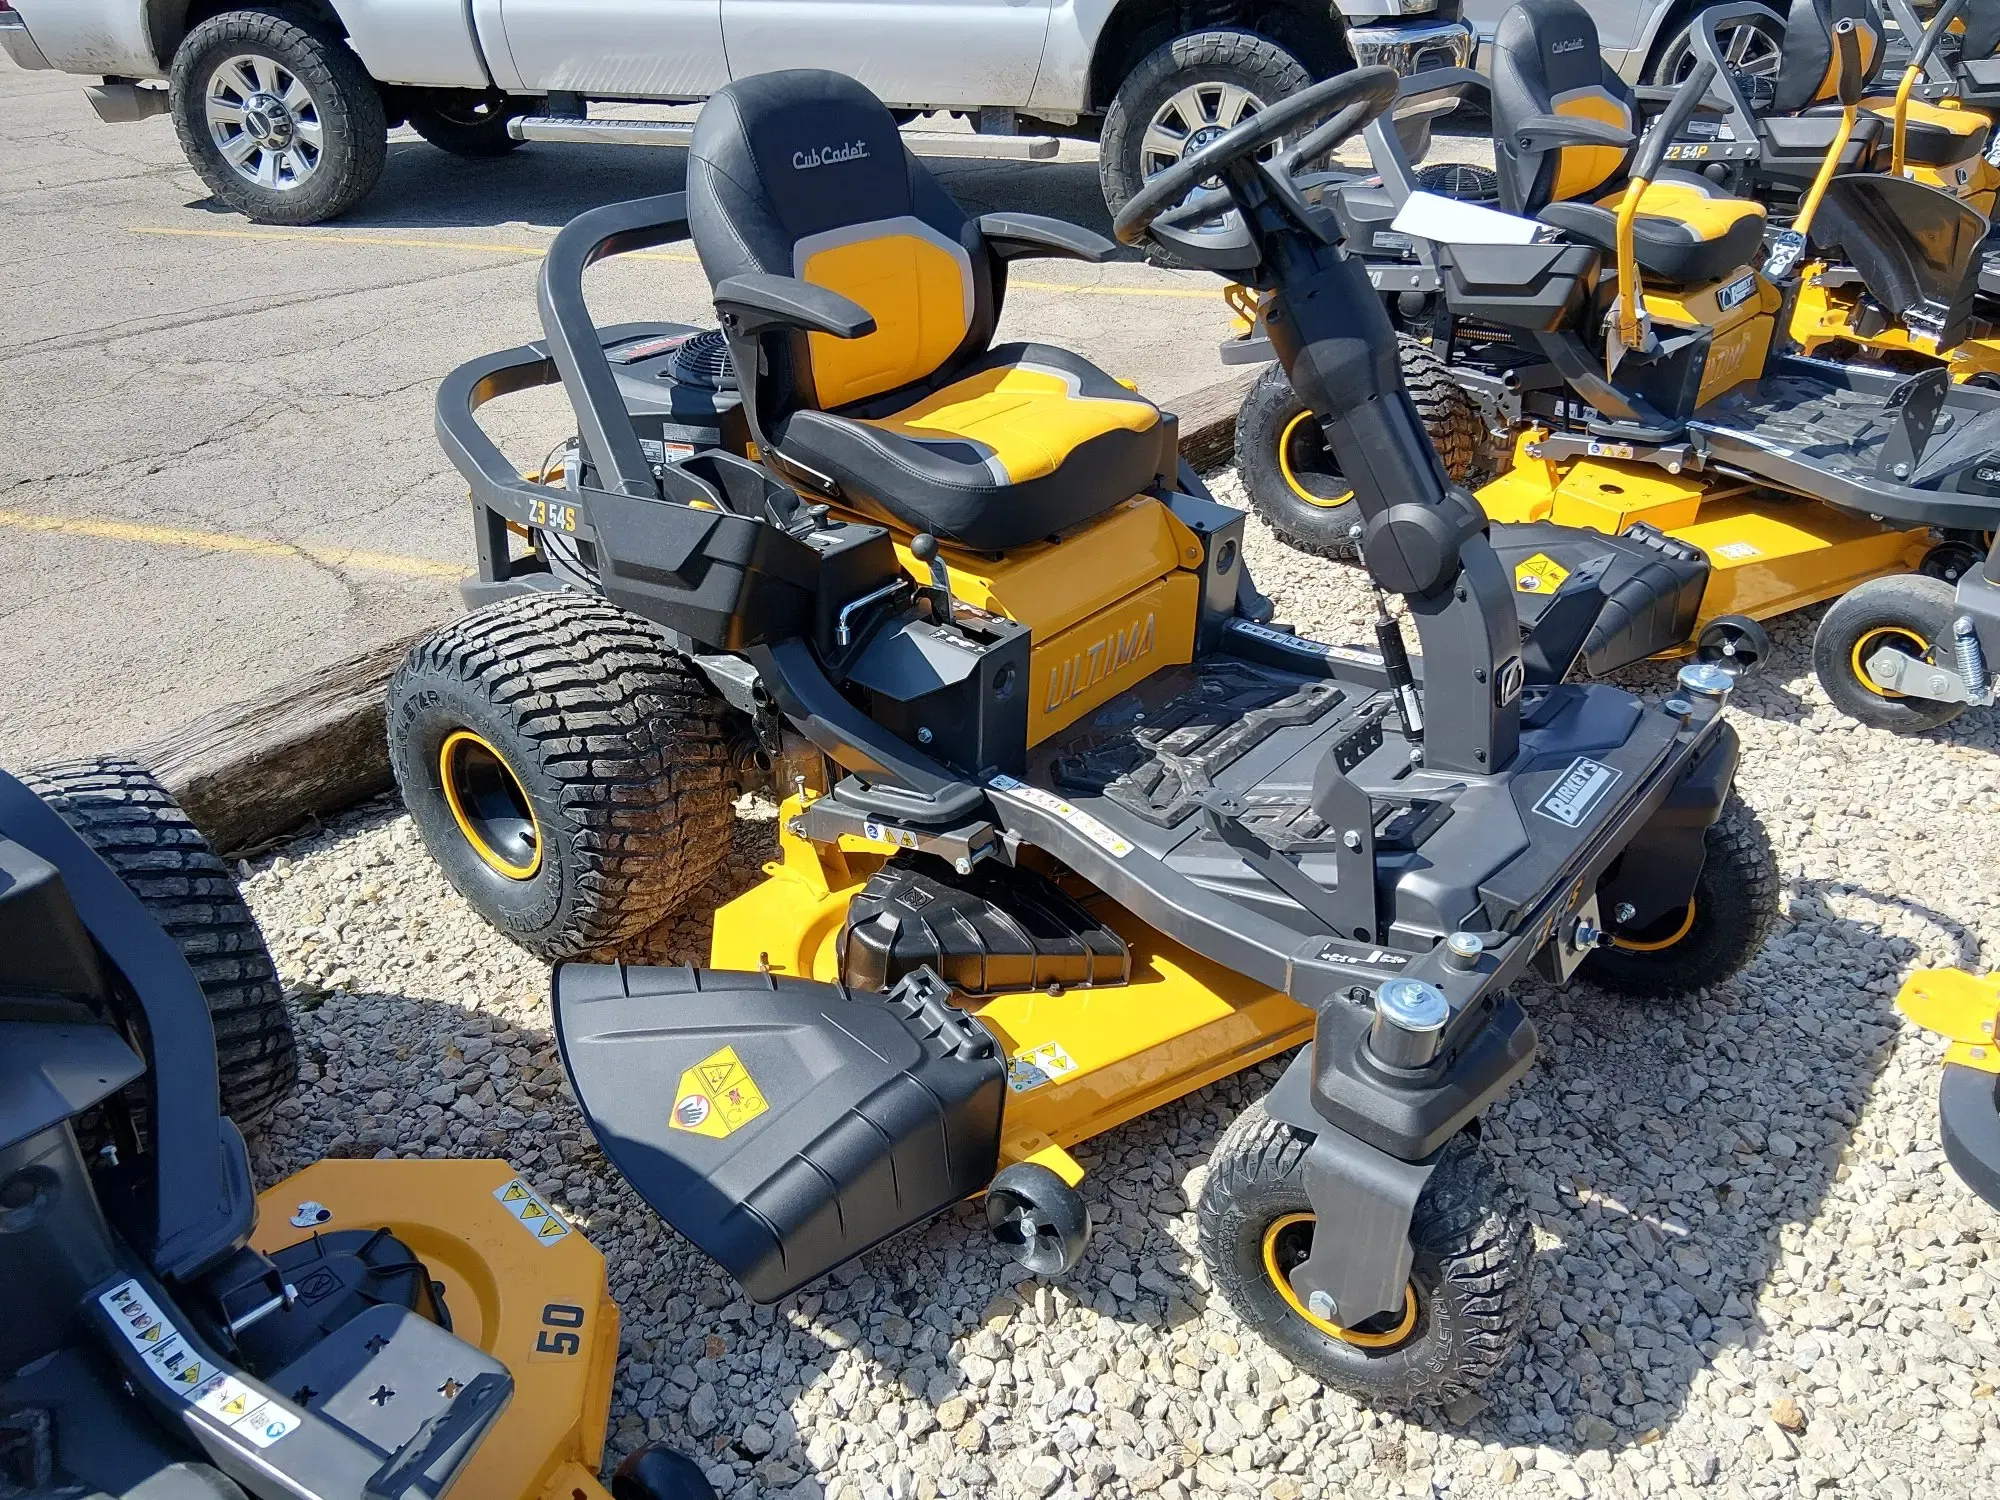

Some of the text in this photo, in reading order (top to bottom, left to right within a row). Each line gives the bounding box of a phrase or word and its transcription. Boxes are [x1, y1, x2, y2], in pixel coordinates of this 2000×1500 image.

[793, 140, 867, 169] Cub Cadet
[1663, 146, 1708, 160] Z2 54P
[529, 499, 576, 532] Z3 54S
[1043, 611, 1154, 713] ULTIMA
[1544, 760, 1598, 824] BIRKEY'S
[536, 1304, 584, 1355] 50
